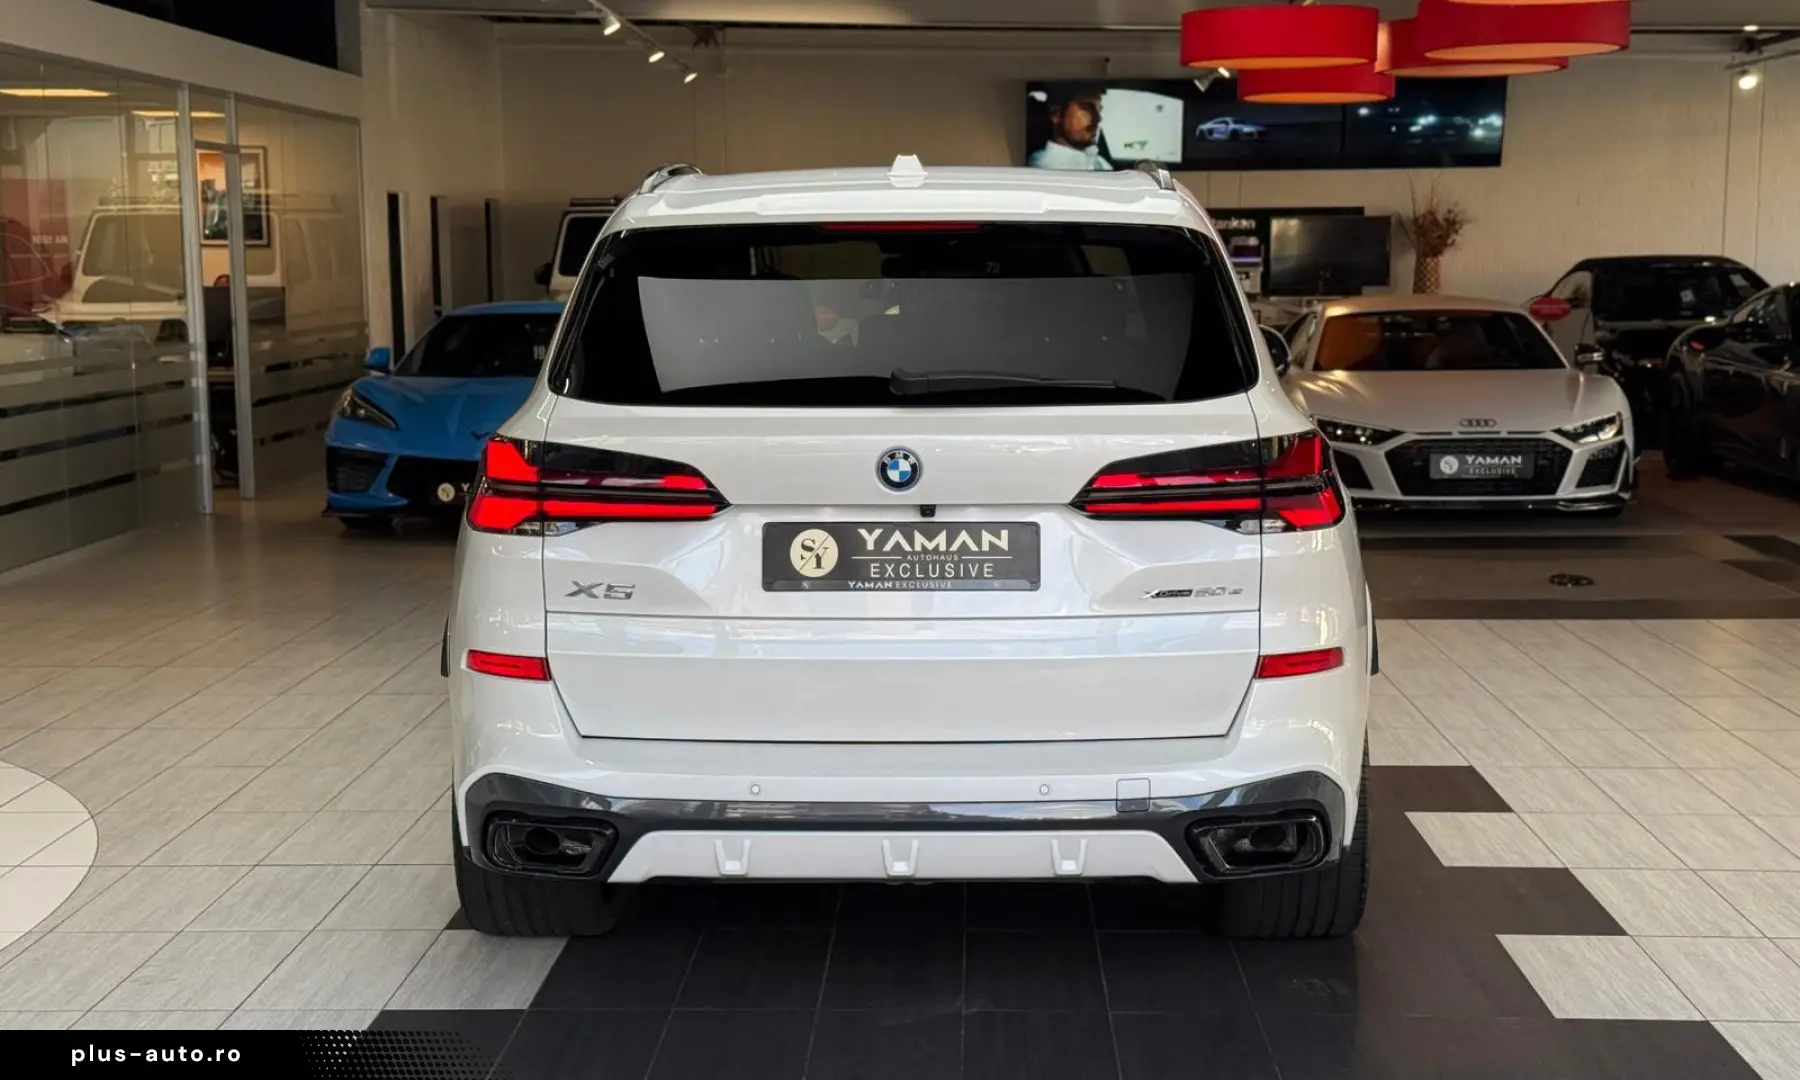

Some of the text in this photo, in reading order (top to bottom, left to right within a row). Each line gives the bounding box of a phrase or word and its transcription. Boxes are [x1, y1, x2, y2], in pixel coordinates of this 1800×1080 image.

[883, 451, 917, 466] BMW
[1465, 455, 1522, 465] YAMAN
[1469, 467, 1516, 475] EXCLUSIVE
[857, 529, 1009, 551] YAMAN
[870, 563, 995, 578] EXCLUSIVE
[564, 580, 636, 600] X5
[848, 581, 953, 589] YAMAN EXCLUSIVE
